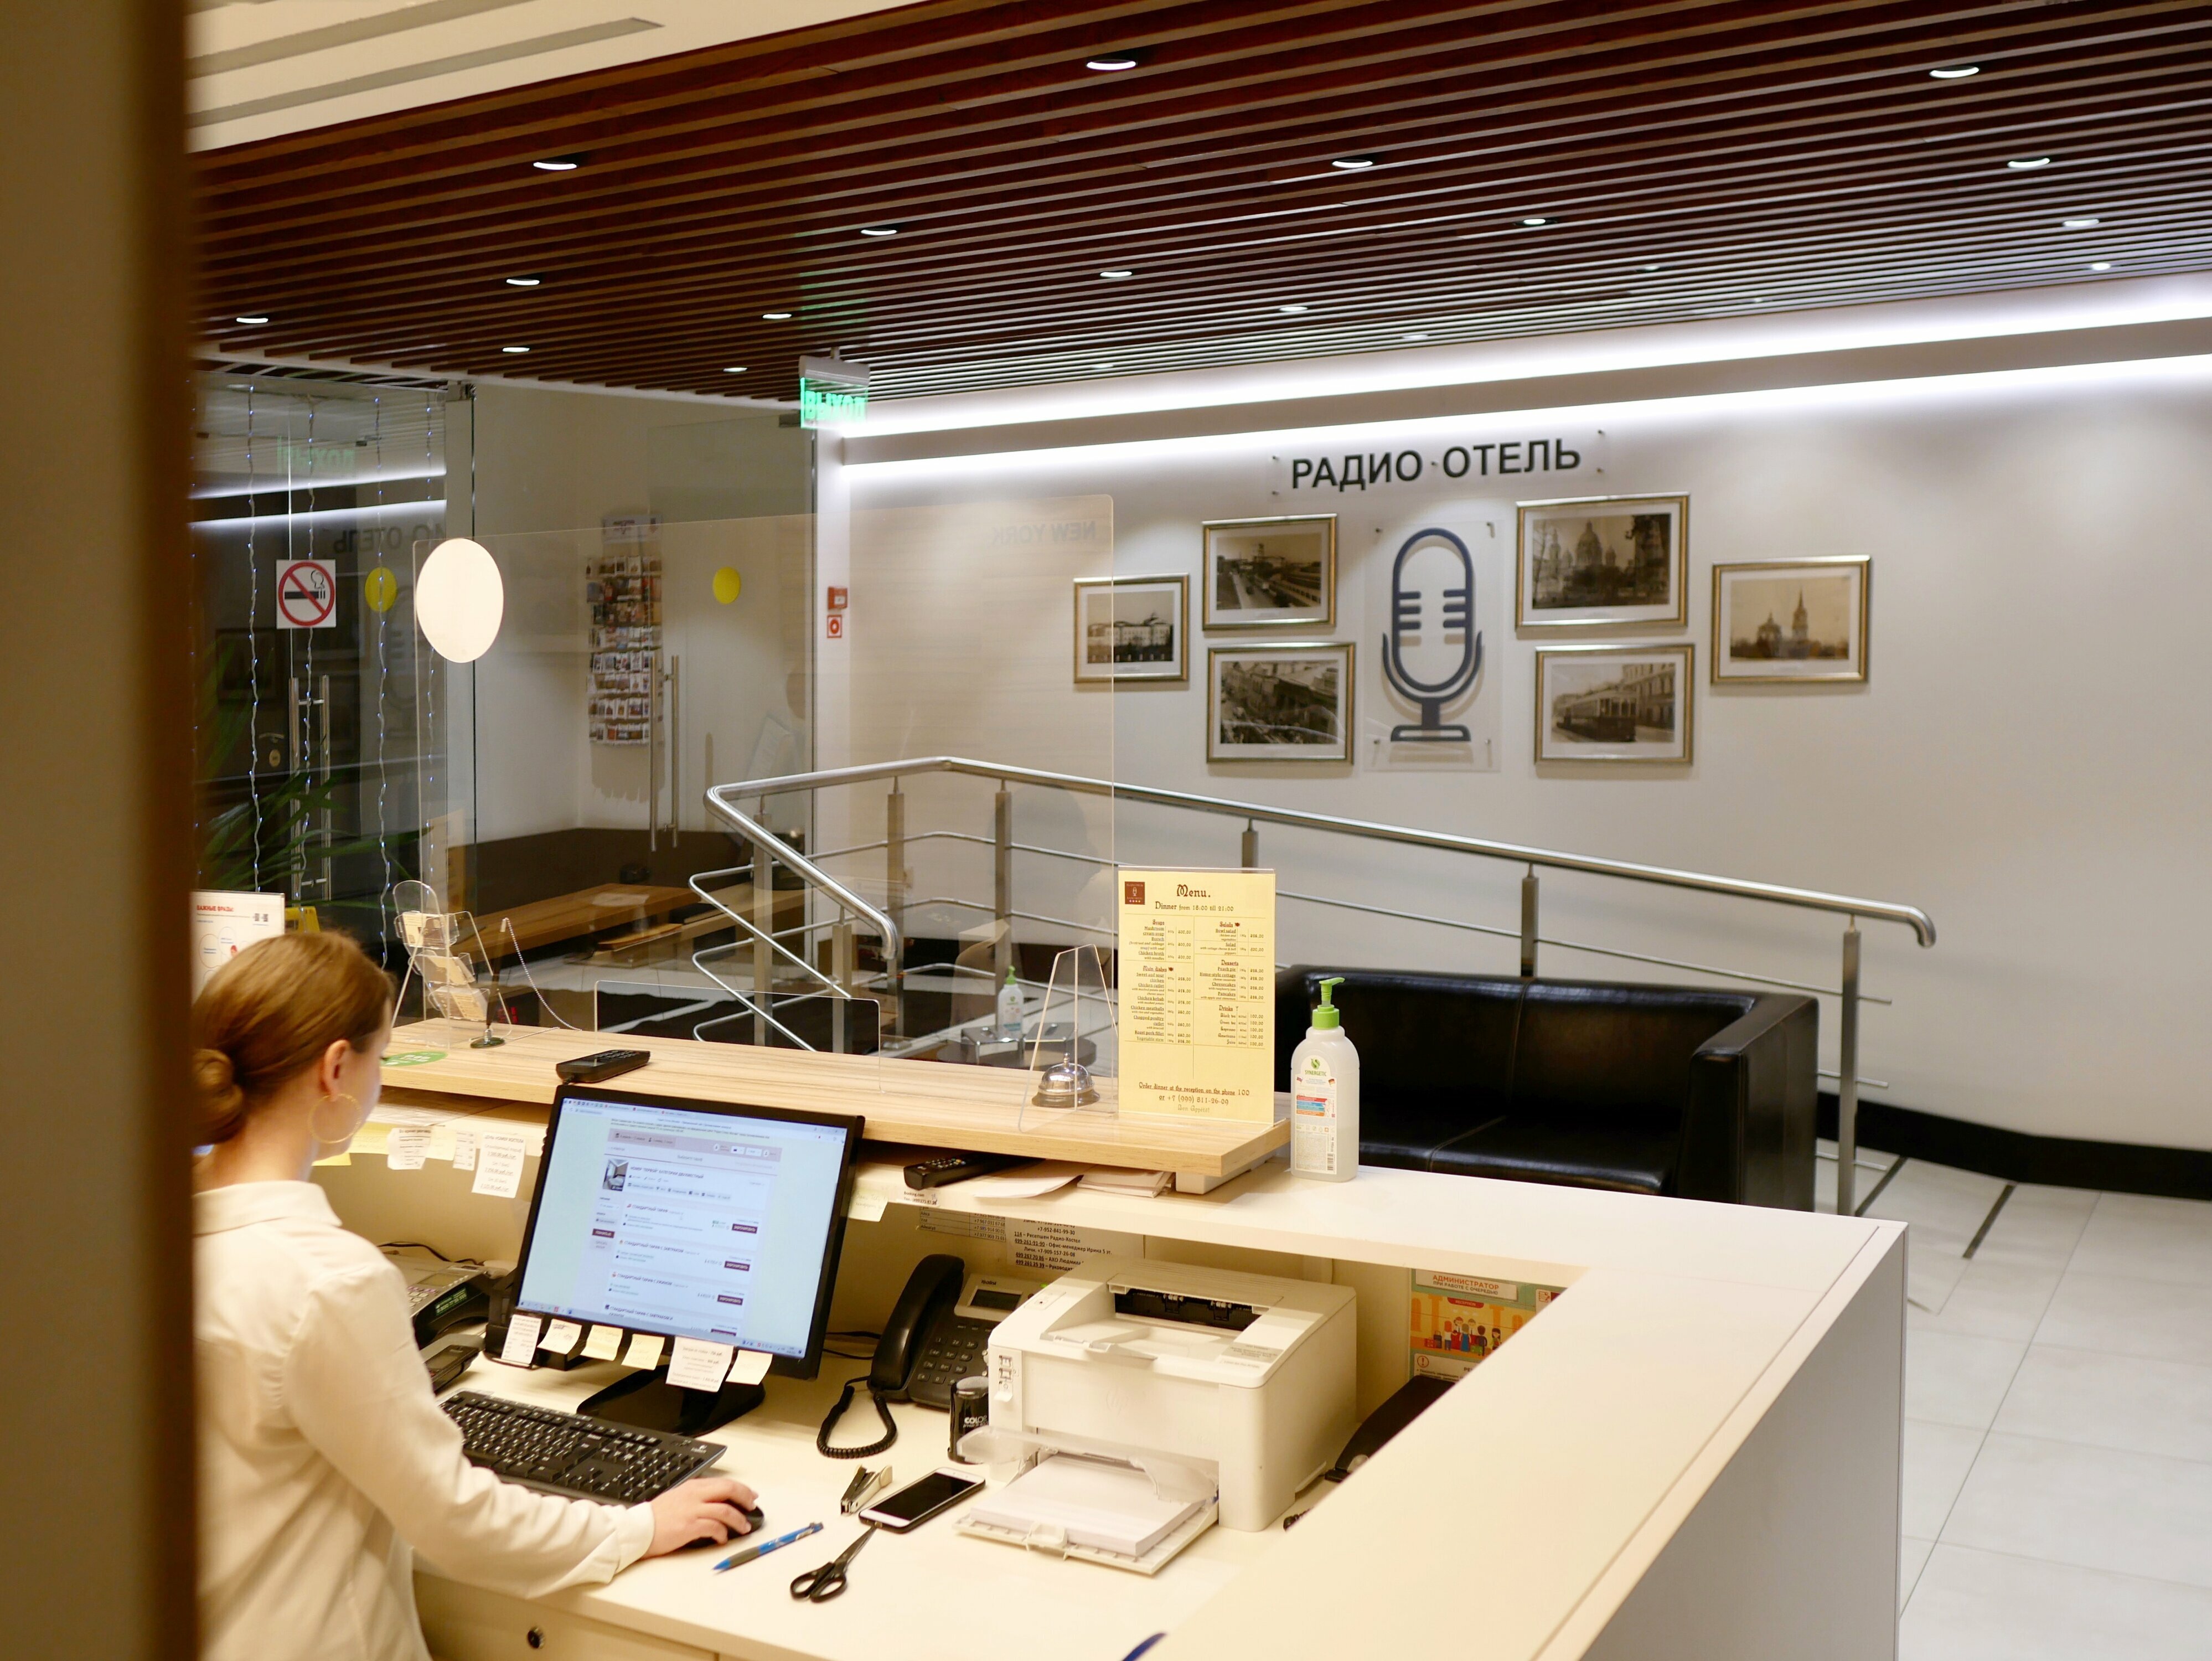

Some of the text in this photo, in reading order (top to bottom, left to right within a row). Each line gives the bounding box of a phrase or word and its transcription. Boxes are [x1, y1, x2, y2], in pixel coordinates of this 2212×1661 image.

[1293, 439, 1581, 492] РАДИО ОТЕЛЬ
[1177, 884, 1211, 897] Menu.
[1155, 901, 1177, 910] Dinner
[1178, 1095, 1194, 1103] (999)
[1037, 1226, 1076, 1235] +7-952-841-99-30
[1015, 1239, 1045, 1247] 499-261-91-90
[1048, 1242, 1086, 1252] Офис-менеджер
[1038, 1249, 1076, 1257] +7-909-157-26-08
[1433, 1275, 1499, 1290] АДМИНИСТРАТОР
[1470, 1286, 1498, 1295] ОЧЕРЕДЬЮ
